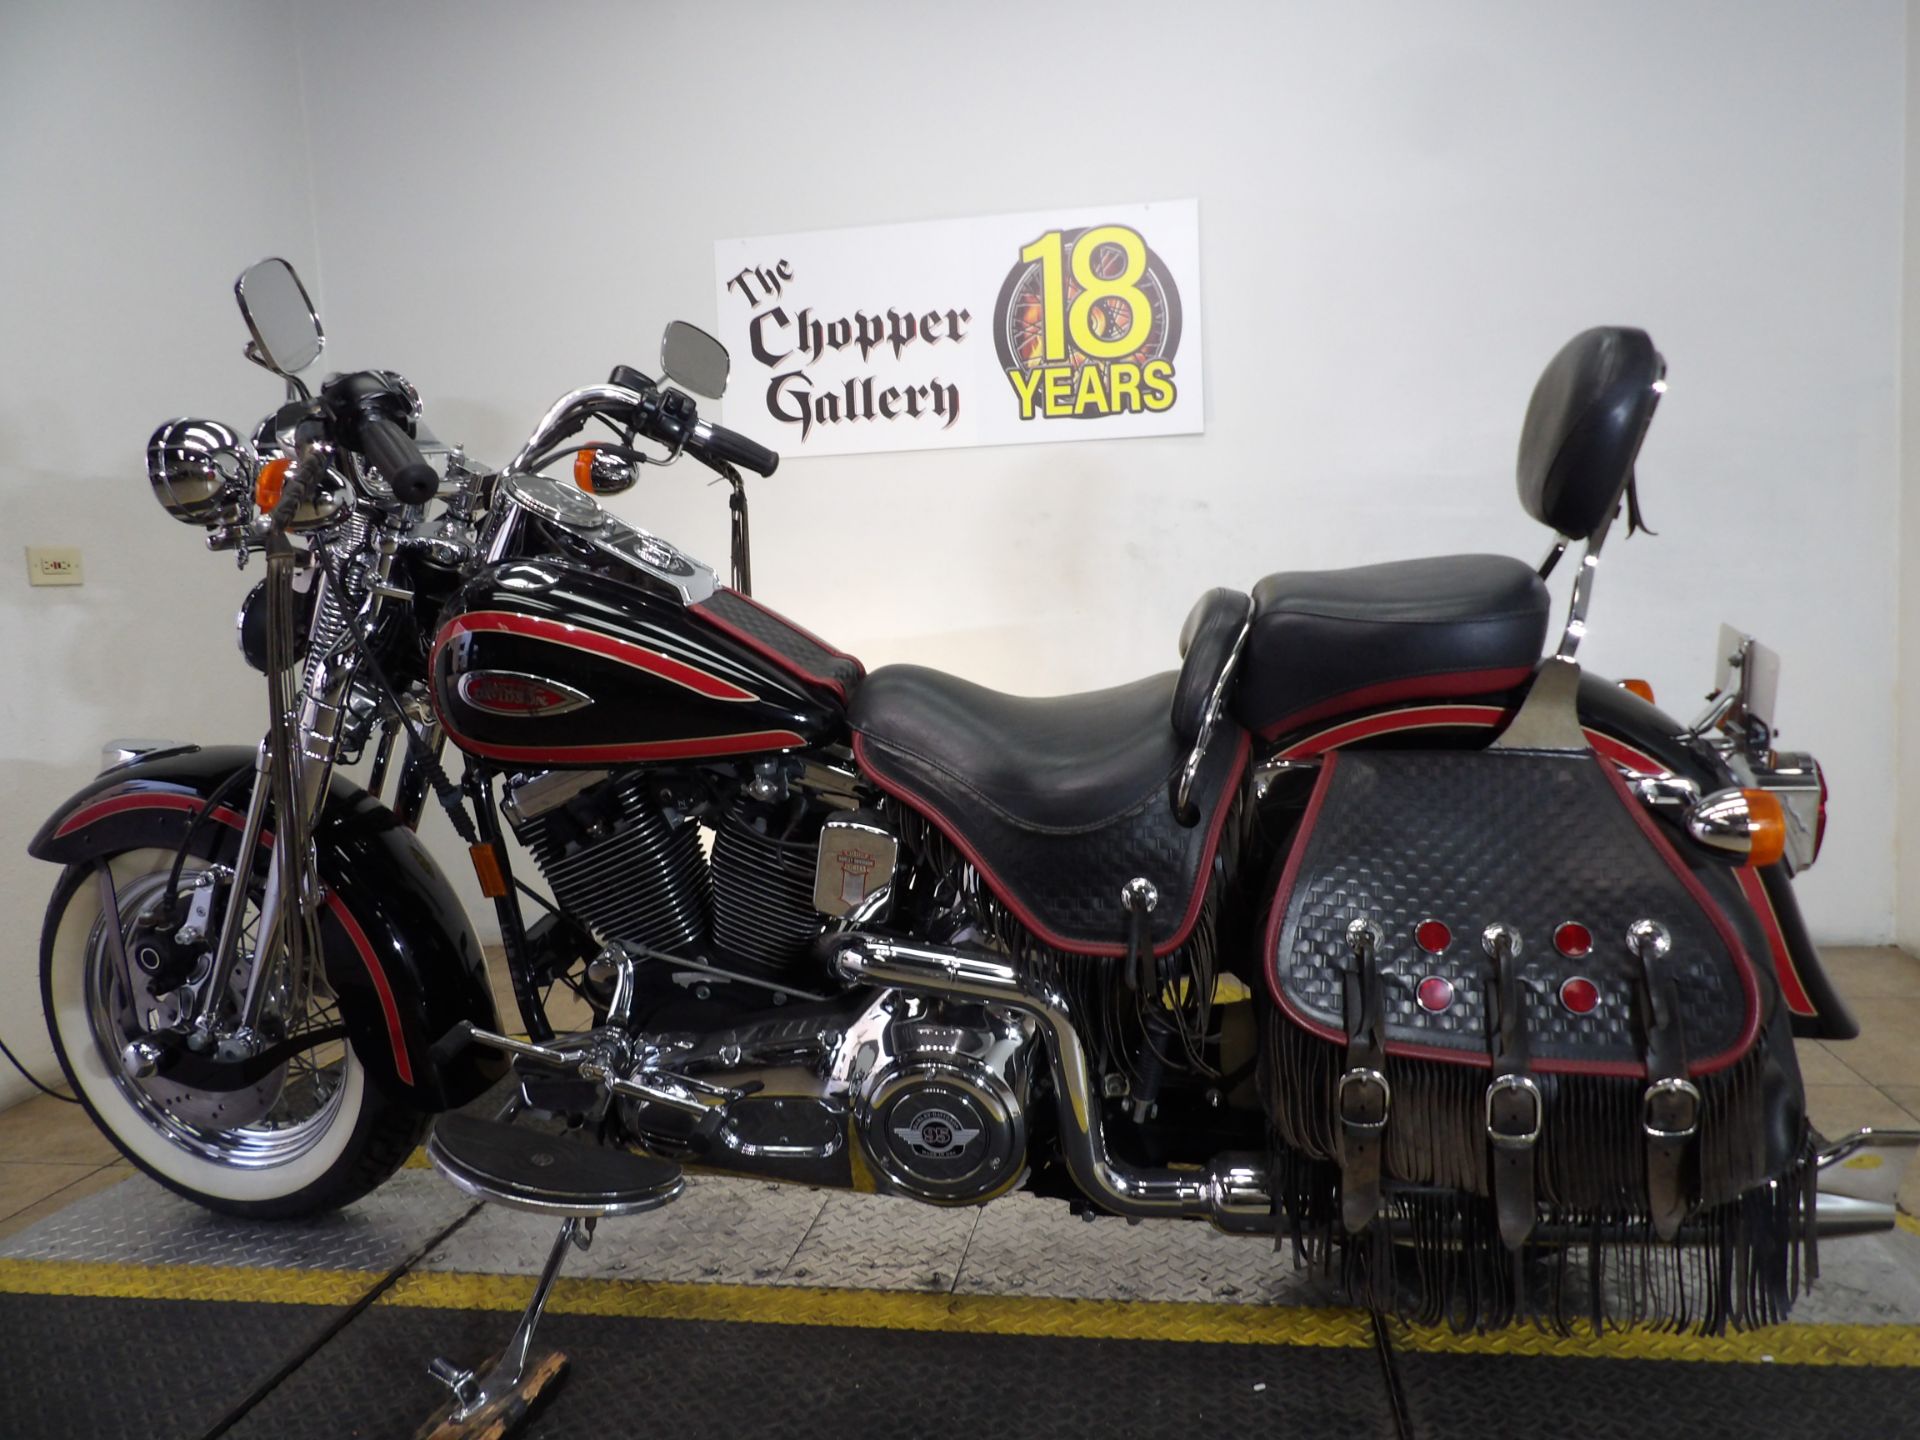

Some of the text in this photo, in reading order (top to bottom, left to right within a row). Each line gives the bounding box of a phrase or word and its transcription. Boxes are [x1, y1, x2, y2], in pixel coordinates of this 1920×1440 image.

[727, 257, 794, 309] The
[1021, 225, 1154, 361] 18
[749, 306, 972, 368] Chopper
[766, 370, 961, 443] Gallery
[1008, 358, 1176, 419] YEARS
[923, 1126, 951, 1144] 95
